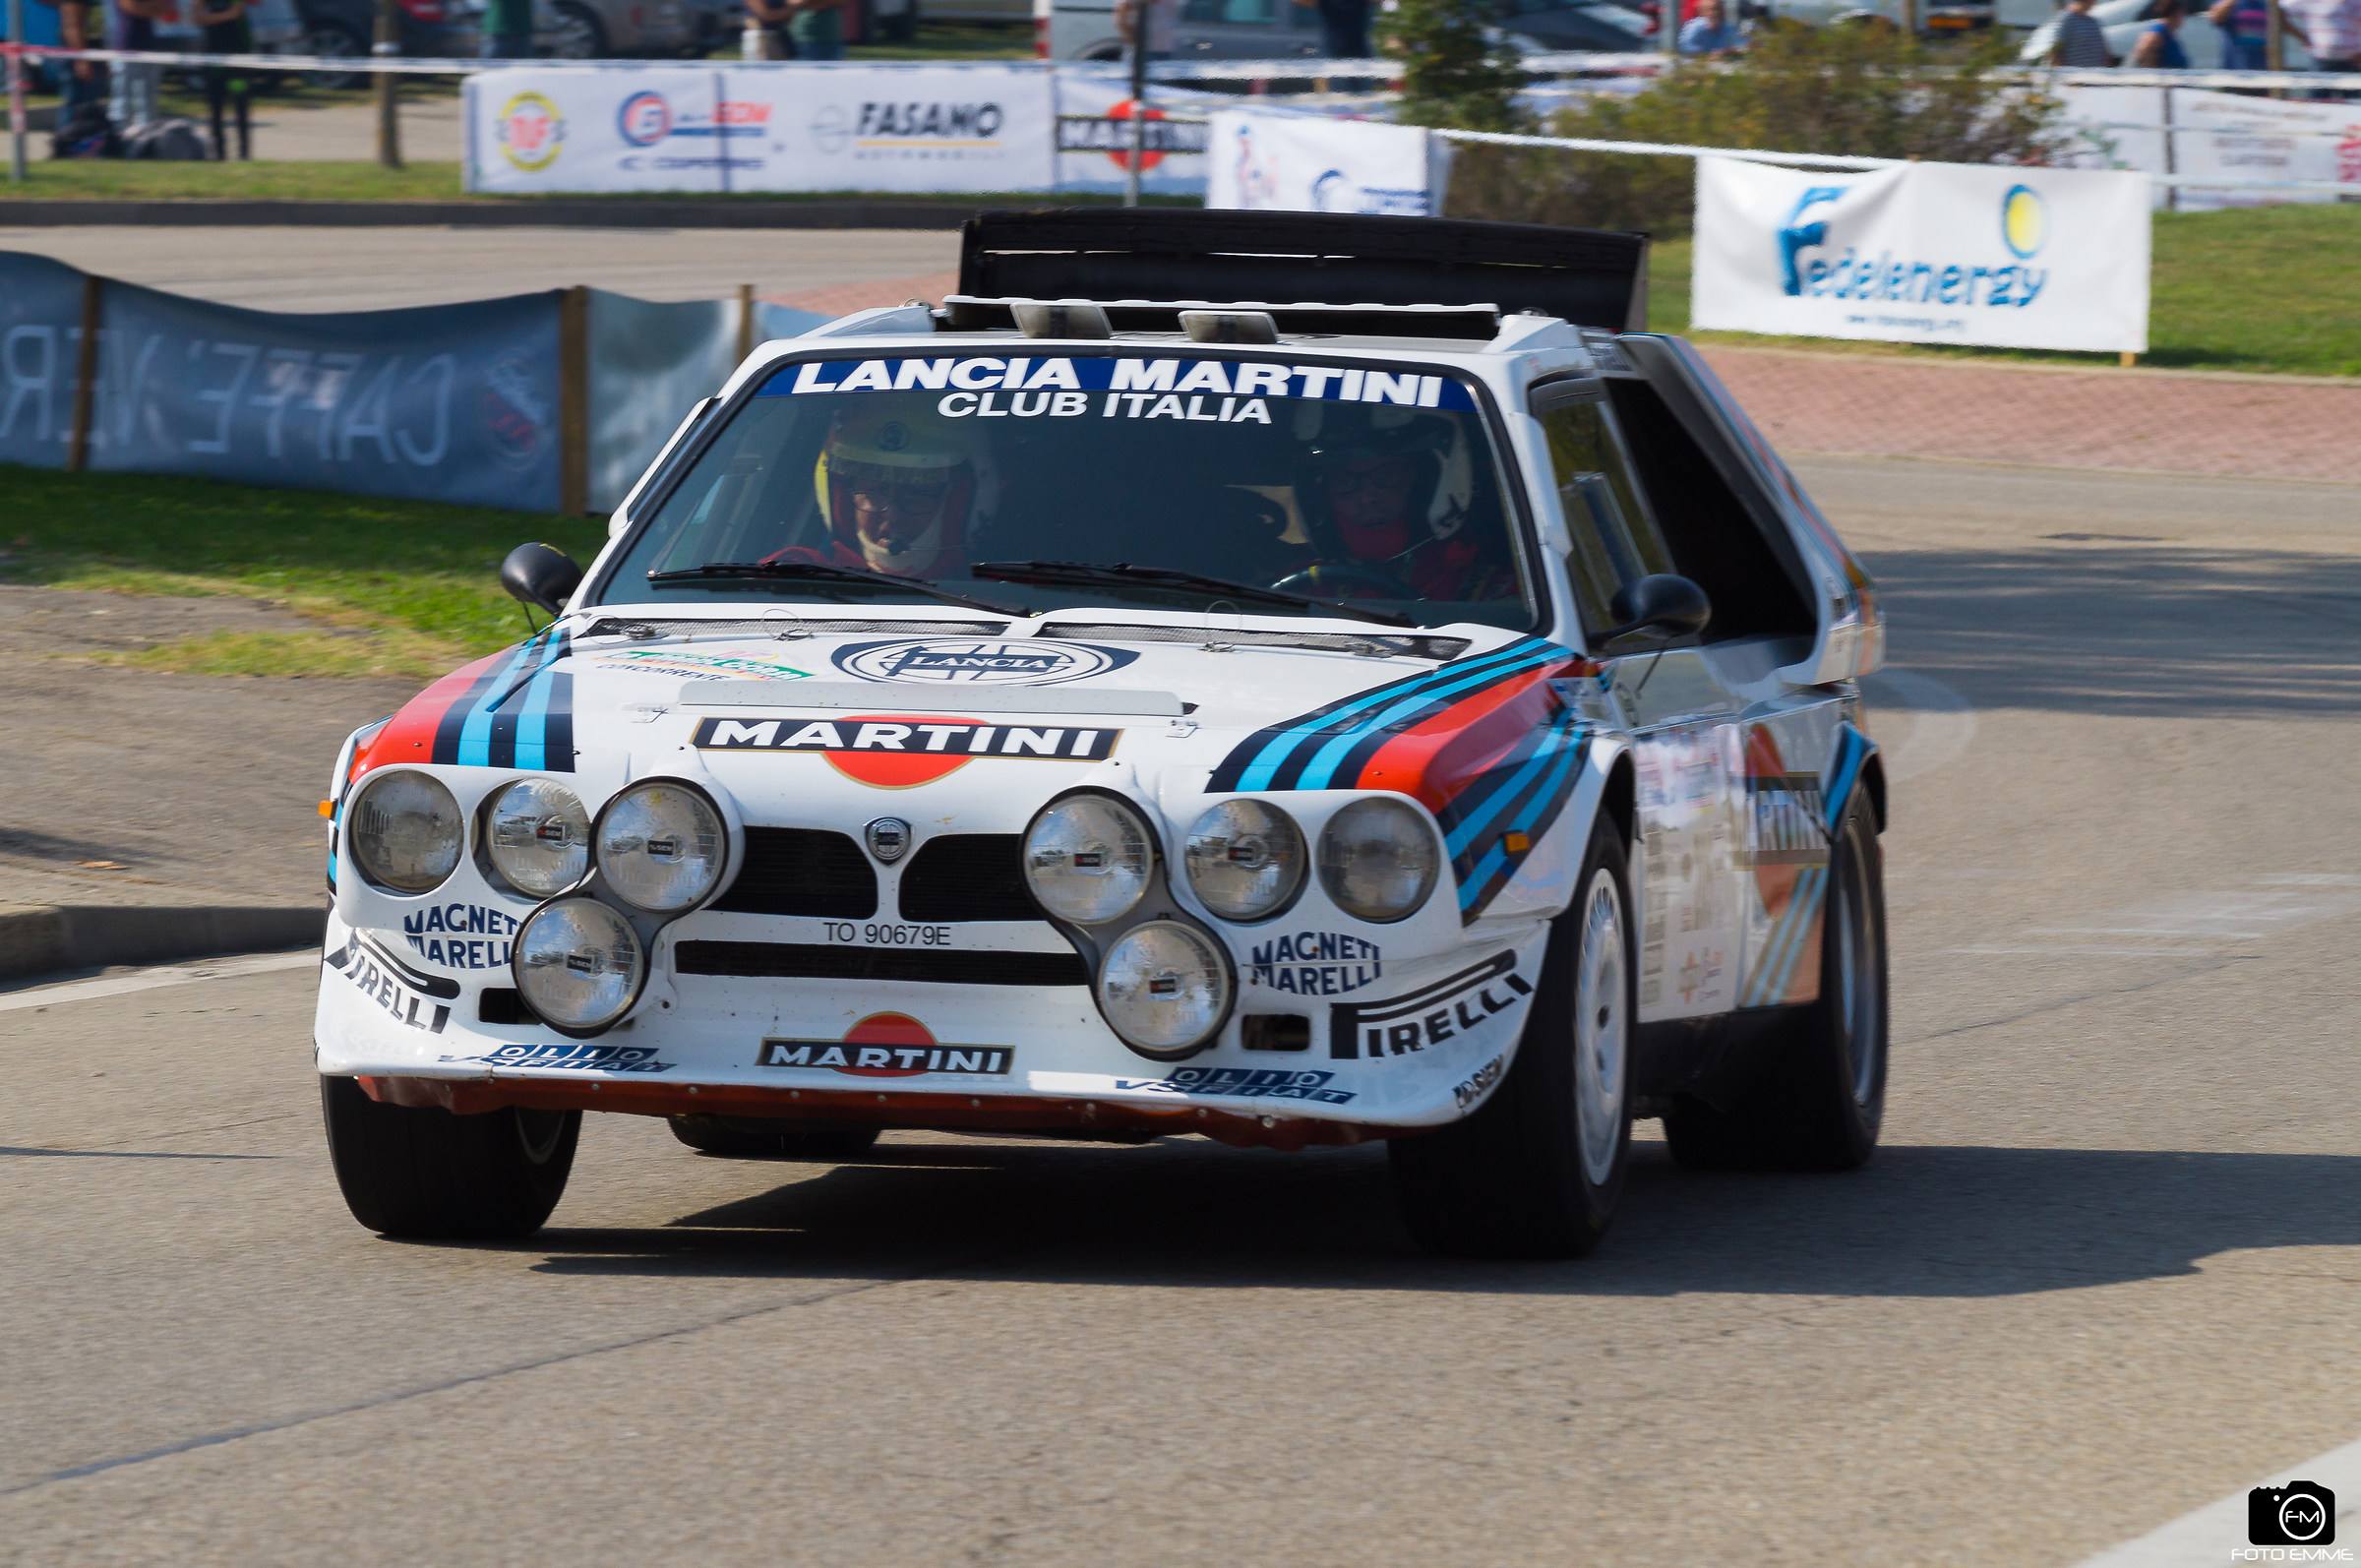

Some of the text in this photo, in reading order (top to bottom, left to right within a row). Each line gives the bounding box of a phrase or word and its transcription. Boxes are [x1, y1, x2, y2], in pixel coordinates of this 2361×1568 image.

[856, 101, 1002, 137] FASANO
[791, 357, 1443, 408] LANCIA MARTINI
[938, 392, 1273, 425] CLUB ITALIA
[909, 656, 1051, 669] LANCIA
[707, 719, 1100, 756] MARTINI
[403, 903, 522, 935] MAGNET
[823, 923, 951, 946] TO 90679E
[406, 935, 512, 969] MARELL
[1252, 931, 1381, 965] MAGNETI
[1251, 961, 1381, 996] MARELLI
[1330, 947, 1534, 1059] PIRELLI
[499, 1046, 644, 1060] OLIO
[519, 1059, 669, 1071] FIAT
[769, 1046, 1001, 1072] MARTINI
[1175, 1070, 1323, 1086] OLIO
[1198, 1086, 1352, 1102] FIAT
